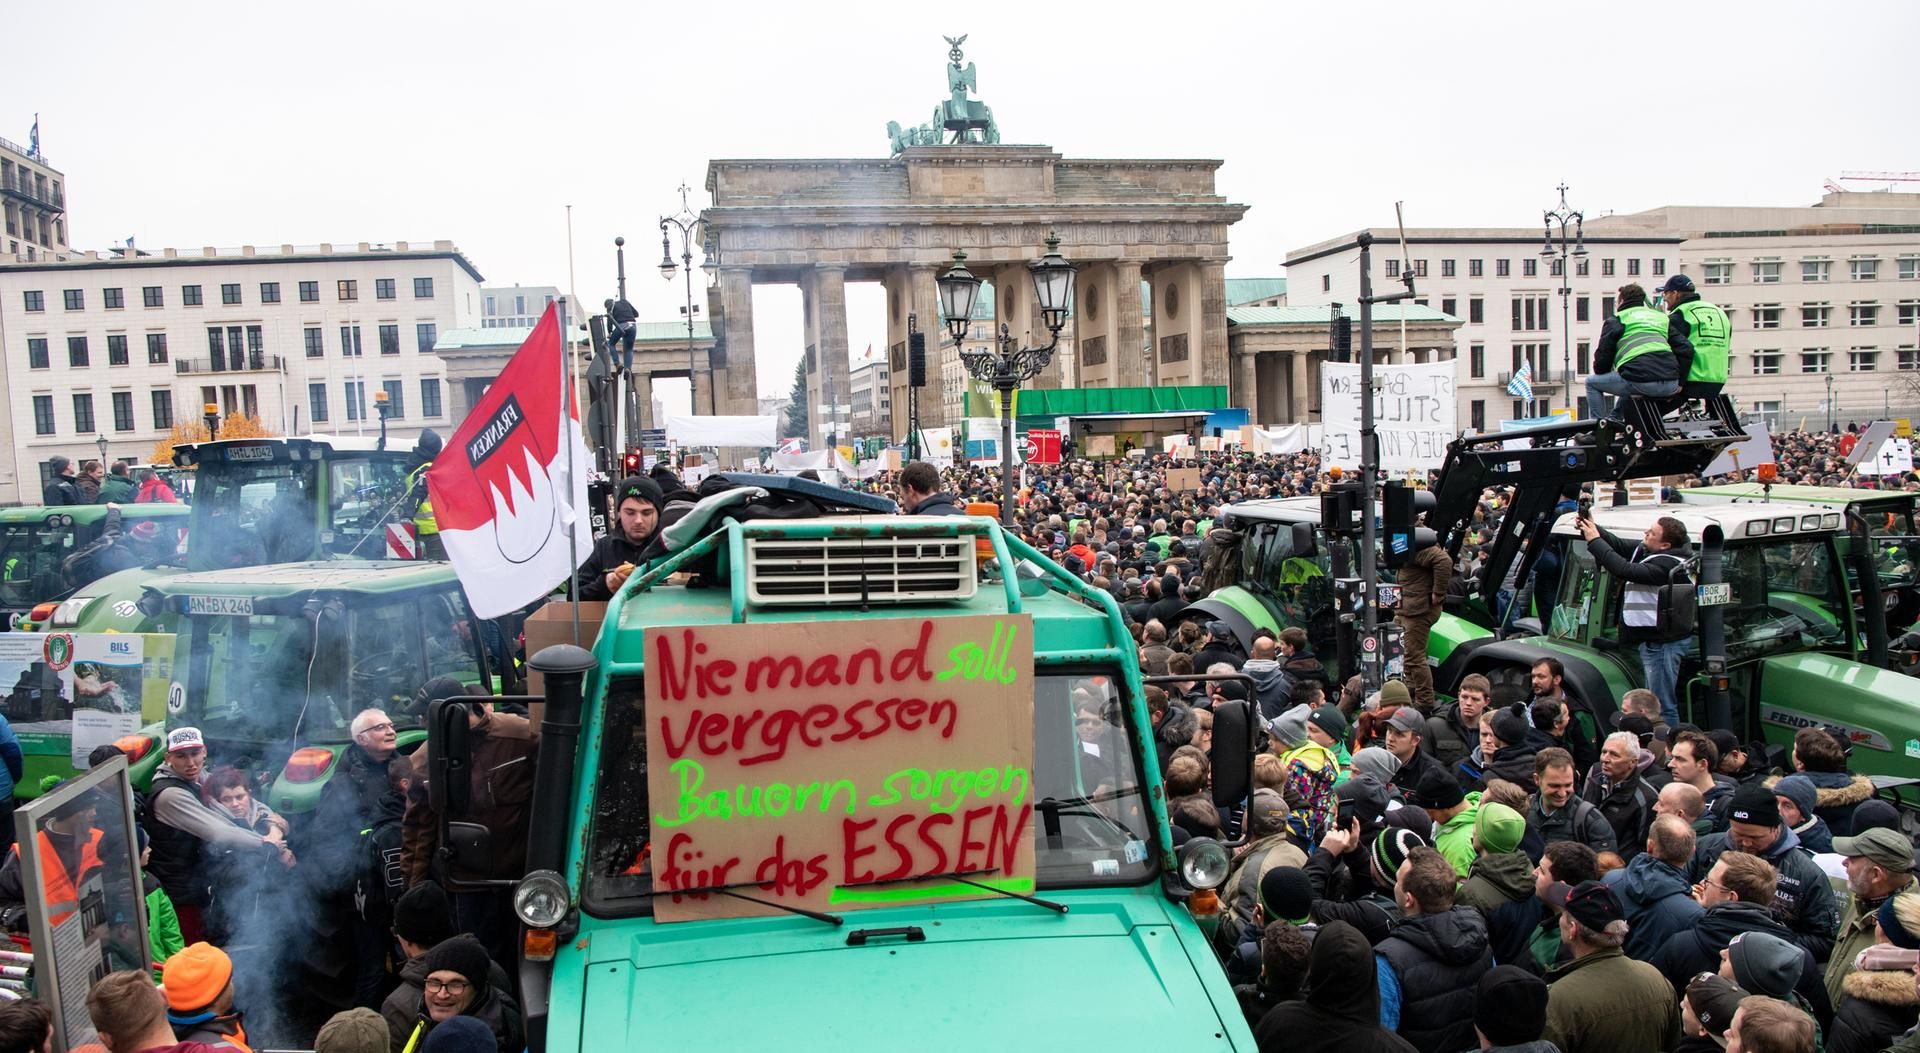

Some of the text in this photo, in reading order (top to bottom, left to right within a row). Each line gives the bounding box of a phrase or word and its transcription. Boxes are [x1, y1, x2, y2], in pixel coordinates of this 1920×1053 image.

[190, 598, 252, 614] AN BX 246
[110, 642, 129, 651] BILS
[656, 620, 1017, 702] Niemand soll
[169, 686, 182, 709] 40
[661, 698, 958, 767] vergessen
[1770, 711, 1819, 729] FENDT
[867, 765, 1030, 815] sorgen
[660, 804, 1032, 904] für das ESSEN
